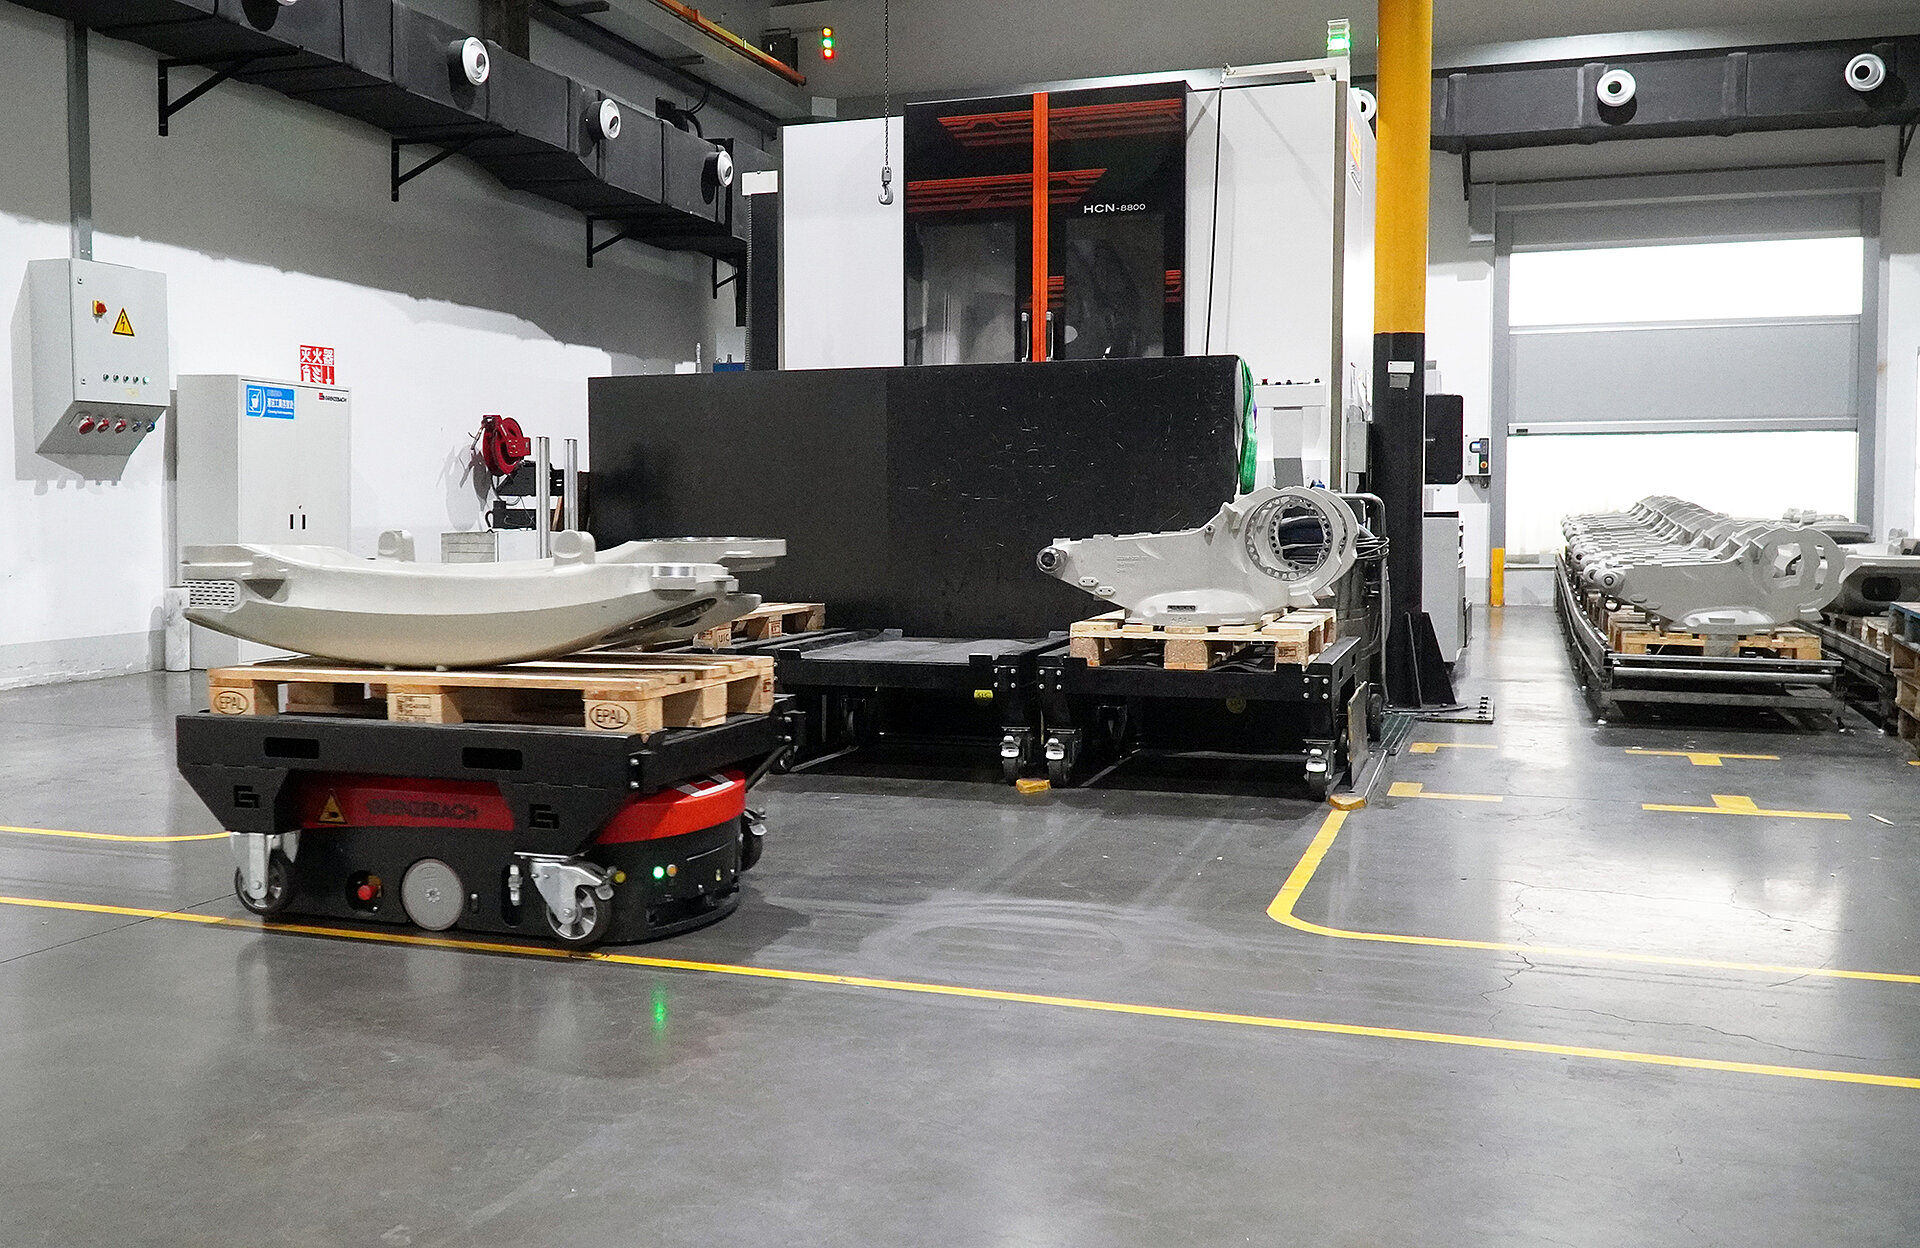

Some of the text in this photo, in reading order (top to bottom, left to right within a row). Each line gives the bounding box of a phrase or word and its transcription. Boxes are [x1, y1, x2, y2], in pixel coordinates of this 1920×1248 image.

[1084, 203, 1146, 214] HCN-8800
[300, 346, 334, 366] 灭火器
[219, 696, 244, 710] EPAL
[595, 708, 625, 724] EPAL
